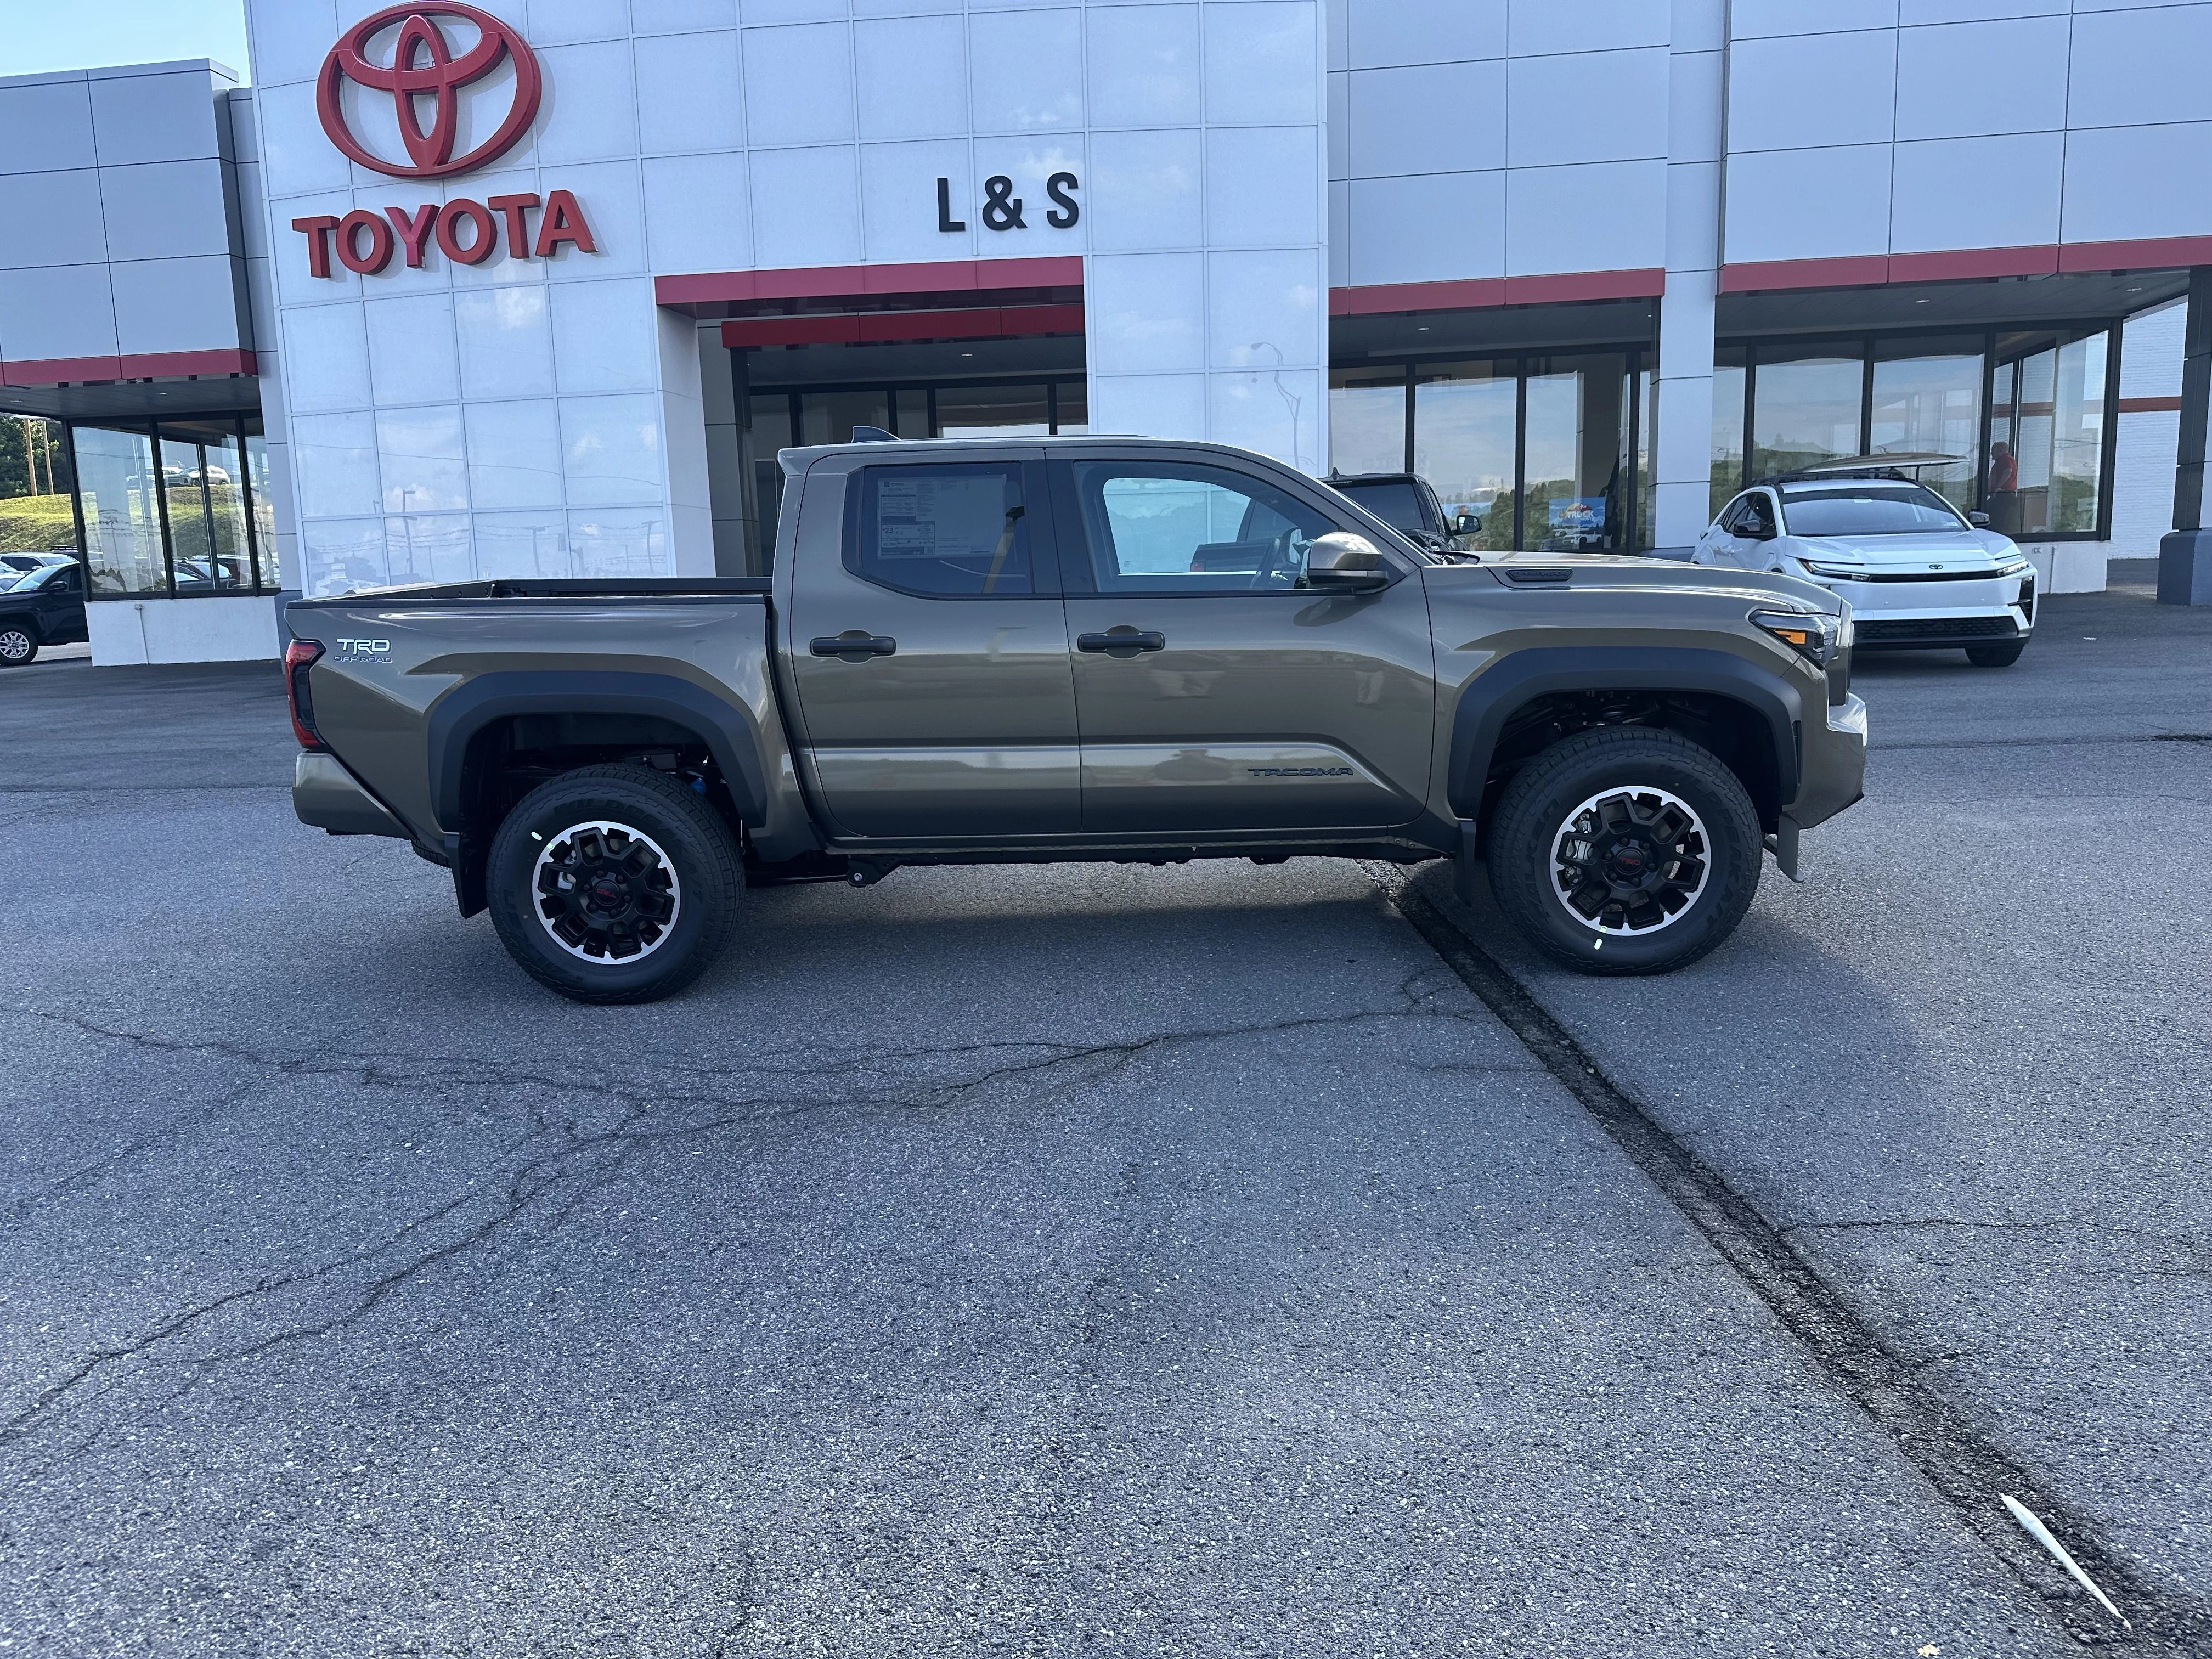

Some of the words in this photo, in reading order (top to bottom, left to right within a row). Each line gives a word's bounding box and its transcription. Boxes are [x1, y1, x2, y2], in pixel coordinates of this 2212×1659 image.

[937, 178, 966, 232] L
[982, 175, 1028, 231] &
[1046, 172, 1079, 228] S
[291, 189, 598, 279] TOYOTA
[336, 639, 391, 655] TRD
[1247, 768, 1353, 777] TACOMA
[1619, 857, 1640, 866] TRD
[597, 889, 618, 898] TRD
